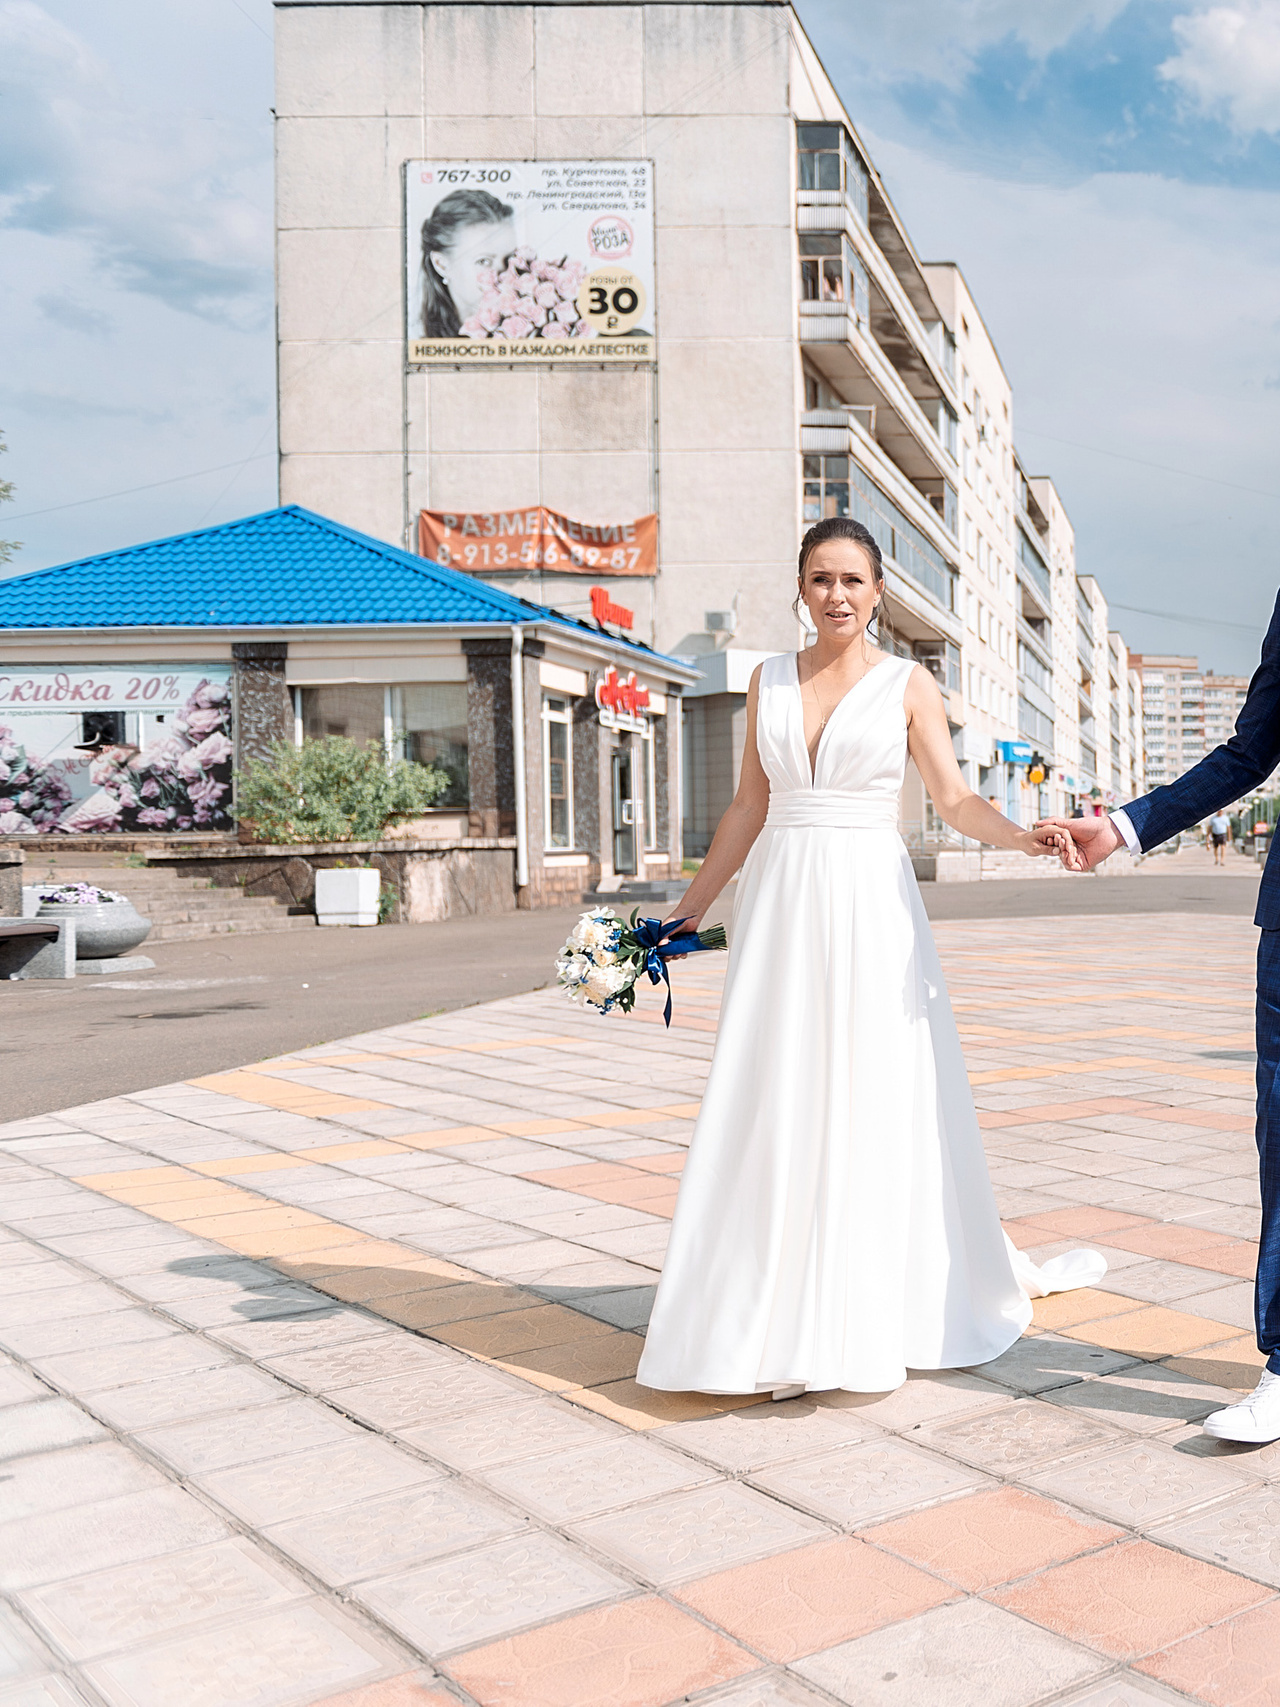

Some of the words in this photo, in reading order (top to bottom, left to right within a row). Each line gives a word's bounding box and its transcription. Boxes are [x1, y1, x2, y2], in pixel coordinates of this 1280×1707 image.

[437, 169, 511, 183] 767-300
[592, 231, 631, 252] РОЗА
[589, 287, 639, 315] 30
[415, 345, 494, 357] НЕЖНОСТЬ
[498, 345, 507, 356] В
[510, 344, 576, 357] КАЖДОМ
[579, 344, 649, 356] ЛЕПЕСТКЕ
[125, 675, 180, 700] 20%
